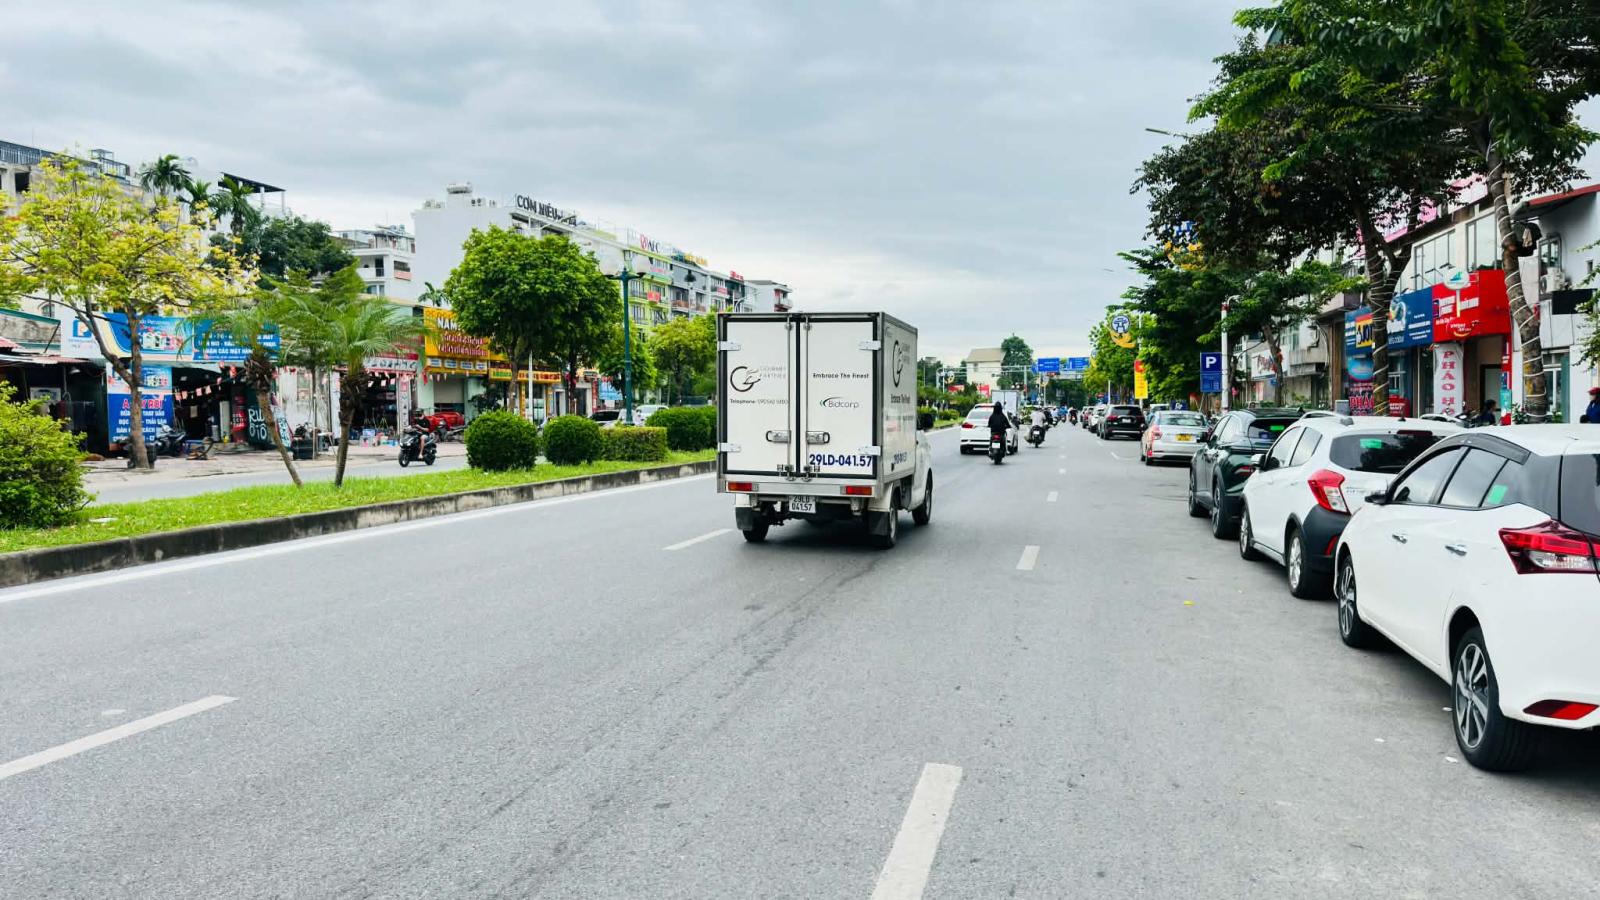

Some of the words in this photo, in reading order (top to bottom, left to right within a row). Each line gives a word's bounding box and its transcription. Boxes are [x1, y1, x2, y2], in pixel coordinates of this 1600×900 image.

[1205, 356, 1217, 368] P
[828, 400, 860, 408] Bidcorp
[809, 454, 872, 467] 29LD-041.57
[791, 503, 813, 511] 041.57
